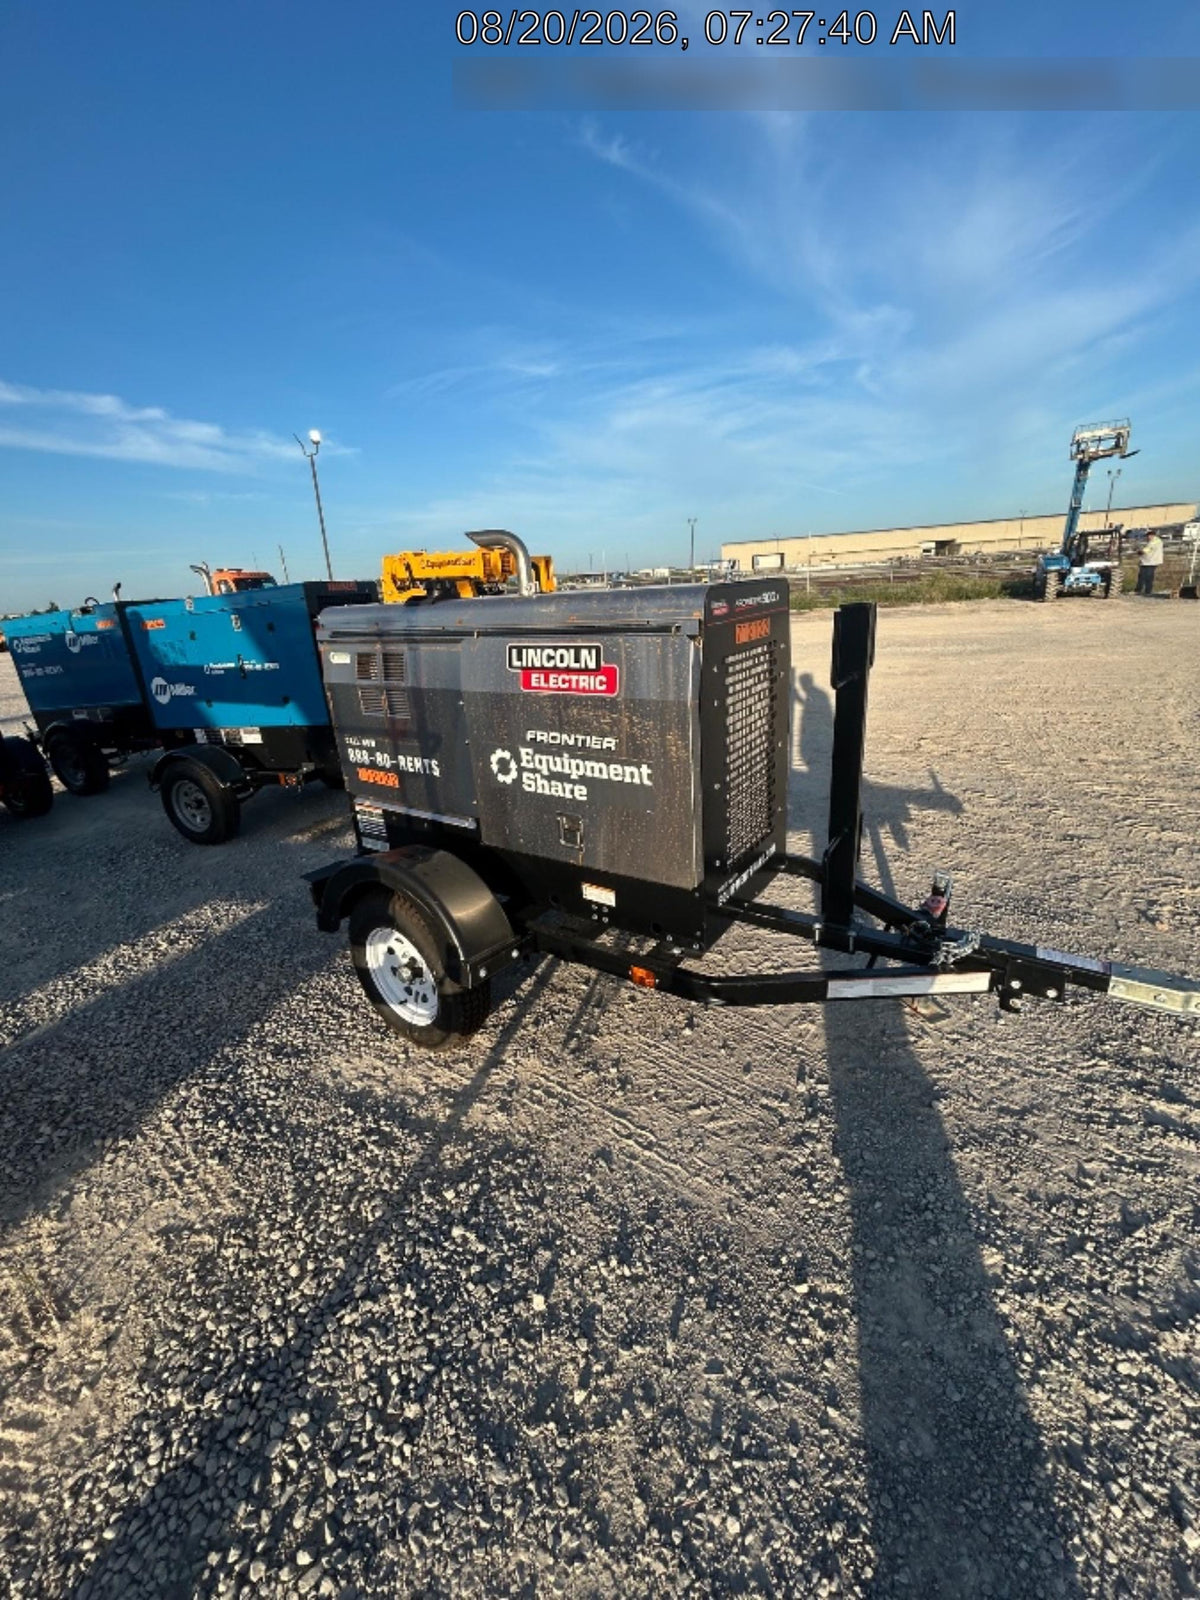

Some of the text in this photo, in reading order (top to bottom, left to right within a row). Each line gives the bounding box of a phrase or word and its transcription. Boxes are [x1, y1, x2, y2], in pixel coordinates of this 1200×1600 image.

[511, 648, 597, 669] LINCOLN
[530, 673, 607, 691] ELECTRIC
[526, 730, 617, 751] FRONTIER
[519, 747, 653, 786] Equipment
[522, 771, 588, 801] Share
